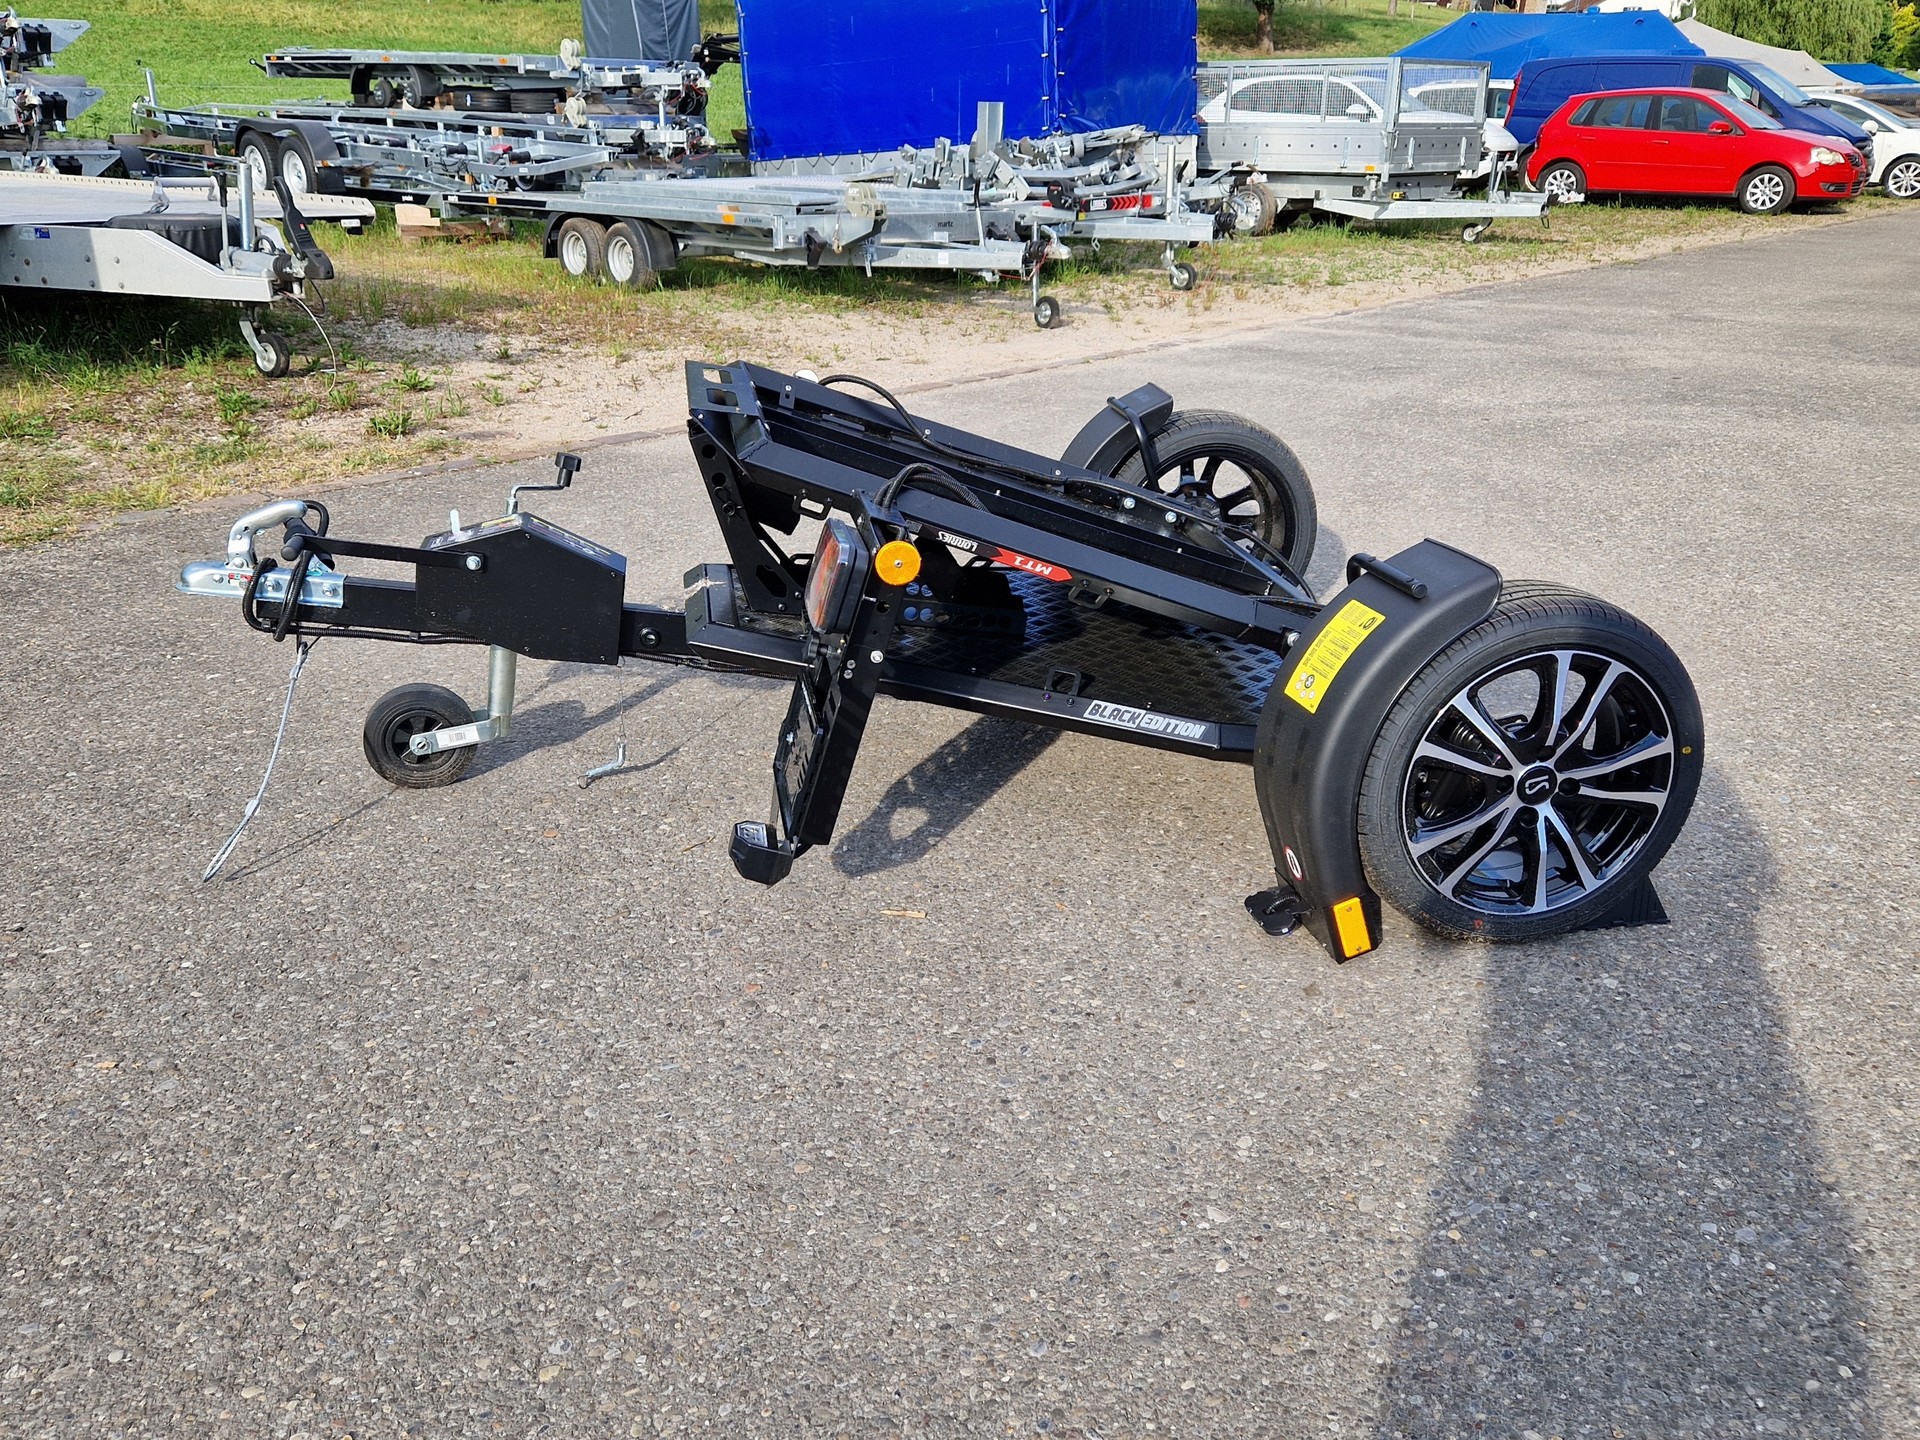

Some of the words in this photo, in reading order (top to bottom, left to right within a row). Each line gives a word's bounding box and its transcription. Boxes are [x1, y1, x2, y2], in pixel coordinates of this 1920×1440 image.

[937, 220, 954, 228] martz
[936, 531, 978, 552] LORRIES
[1014, 555, 1053, 575] MT1
[1088, 703, 1142, 725] BLACK
[1140, 713, 1206, 739] EDITION
